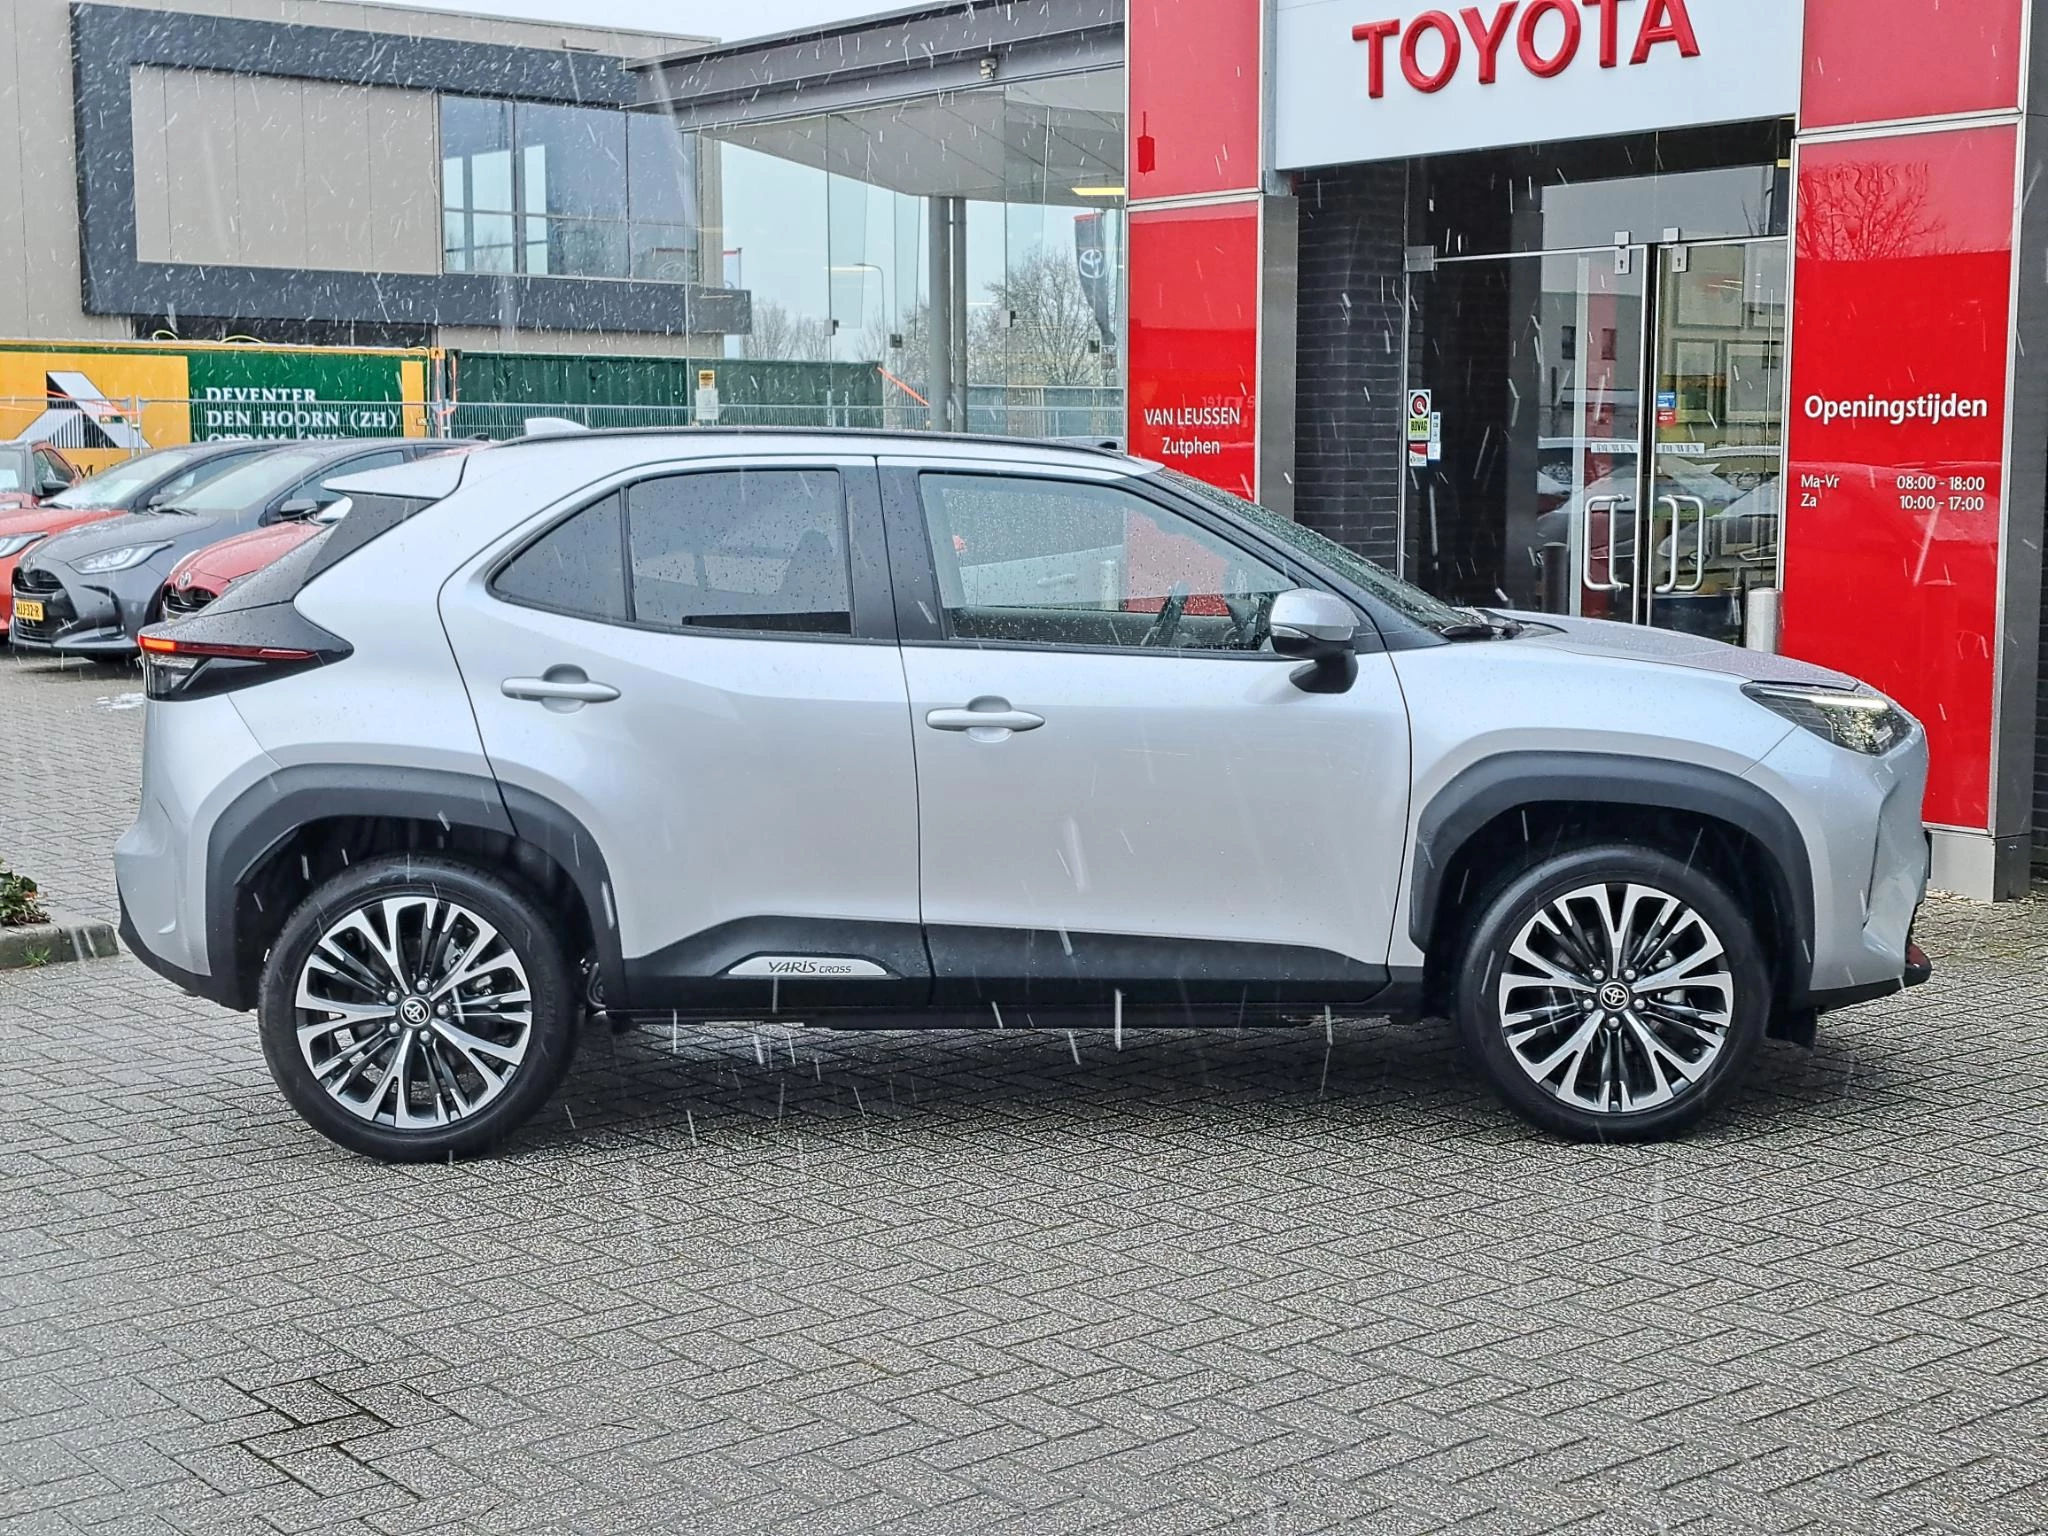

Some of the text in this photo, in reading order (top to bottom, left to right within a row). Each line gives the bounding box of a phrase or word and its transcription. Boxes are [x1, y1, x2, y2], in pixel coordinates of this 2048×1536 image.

[1352, 0, 1701, 99] TOYOTA
[205, 387, 316, 402] DEVENTER
[1144, 407, 1240, 425] VAN LEUSSEN
[1804, 393, 1988, 424] Openingstijden
[207, 409, 396, 430] DEN HOORN (ZH)
[1162, 436, 1220, 459] Zutphen
[1801, 474, 1840, 489] Ma-Vr
[1897, 476, 1936, 490] 08:00
[1950, 476, 1985, 491] 18:00
[1801, 493, 1817, 507] Za
[1900, 496, 1935, 509] 10:00
[1949, 497, 1984, 511] 17:00
[819, 966, 851, 974] CROSS
